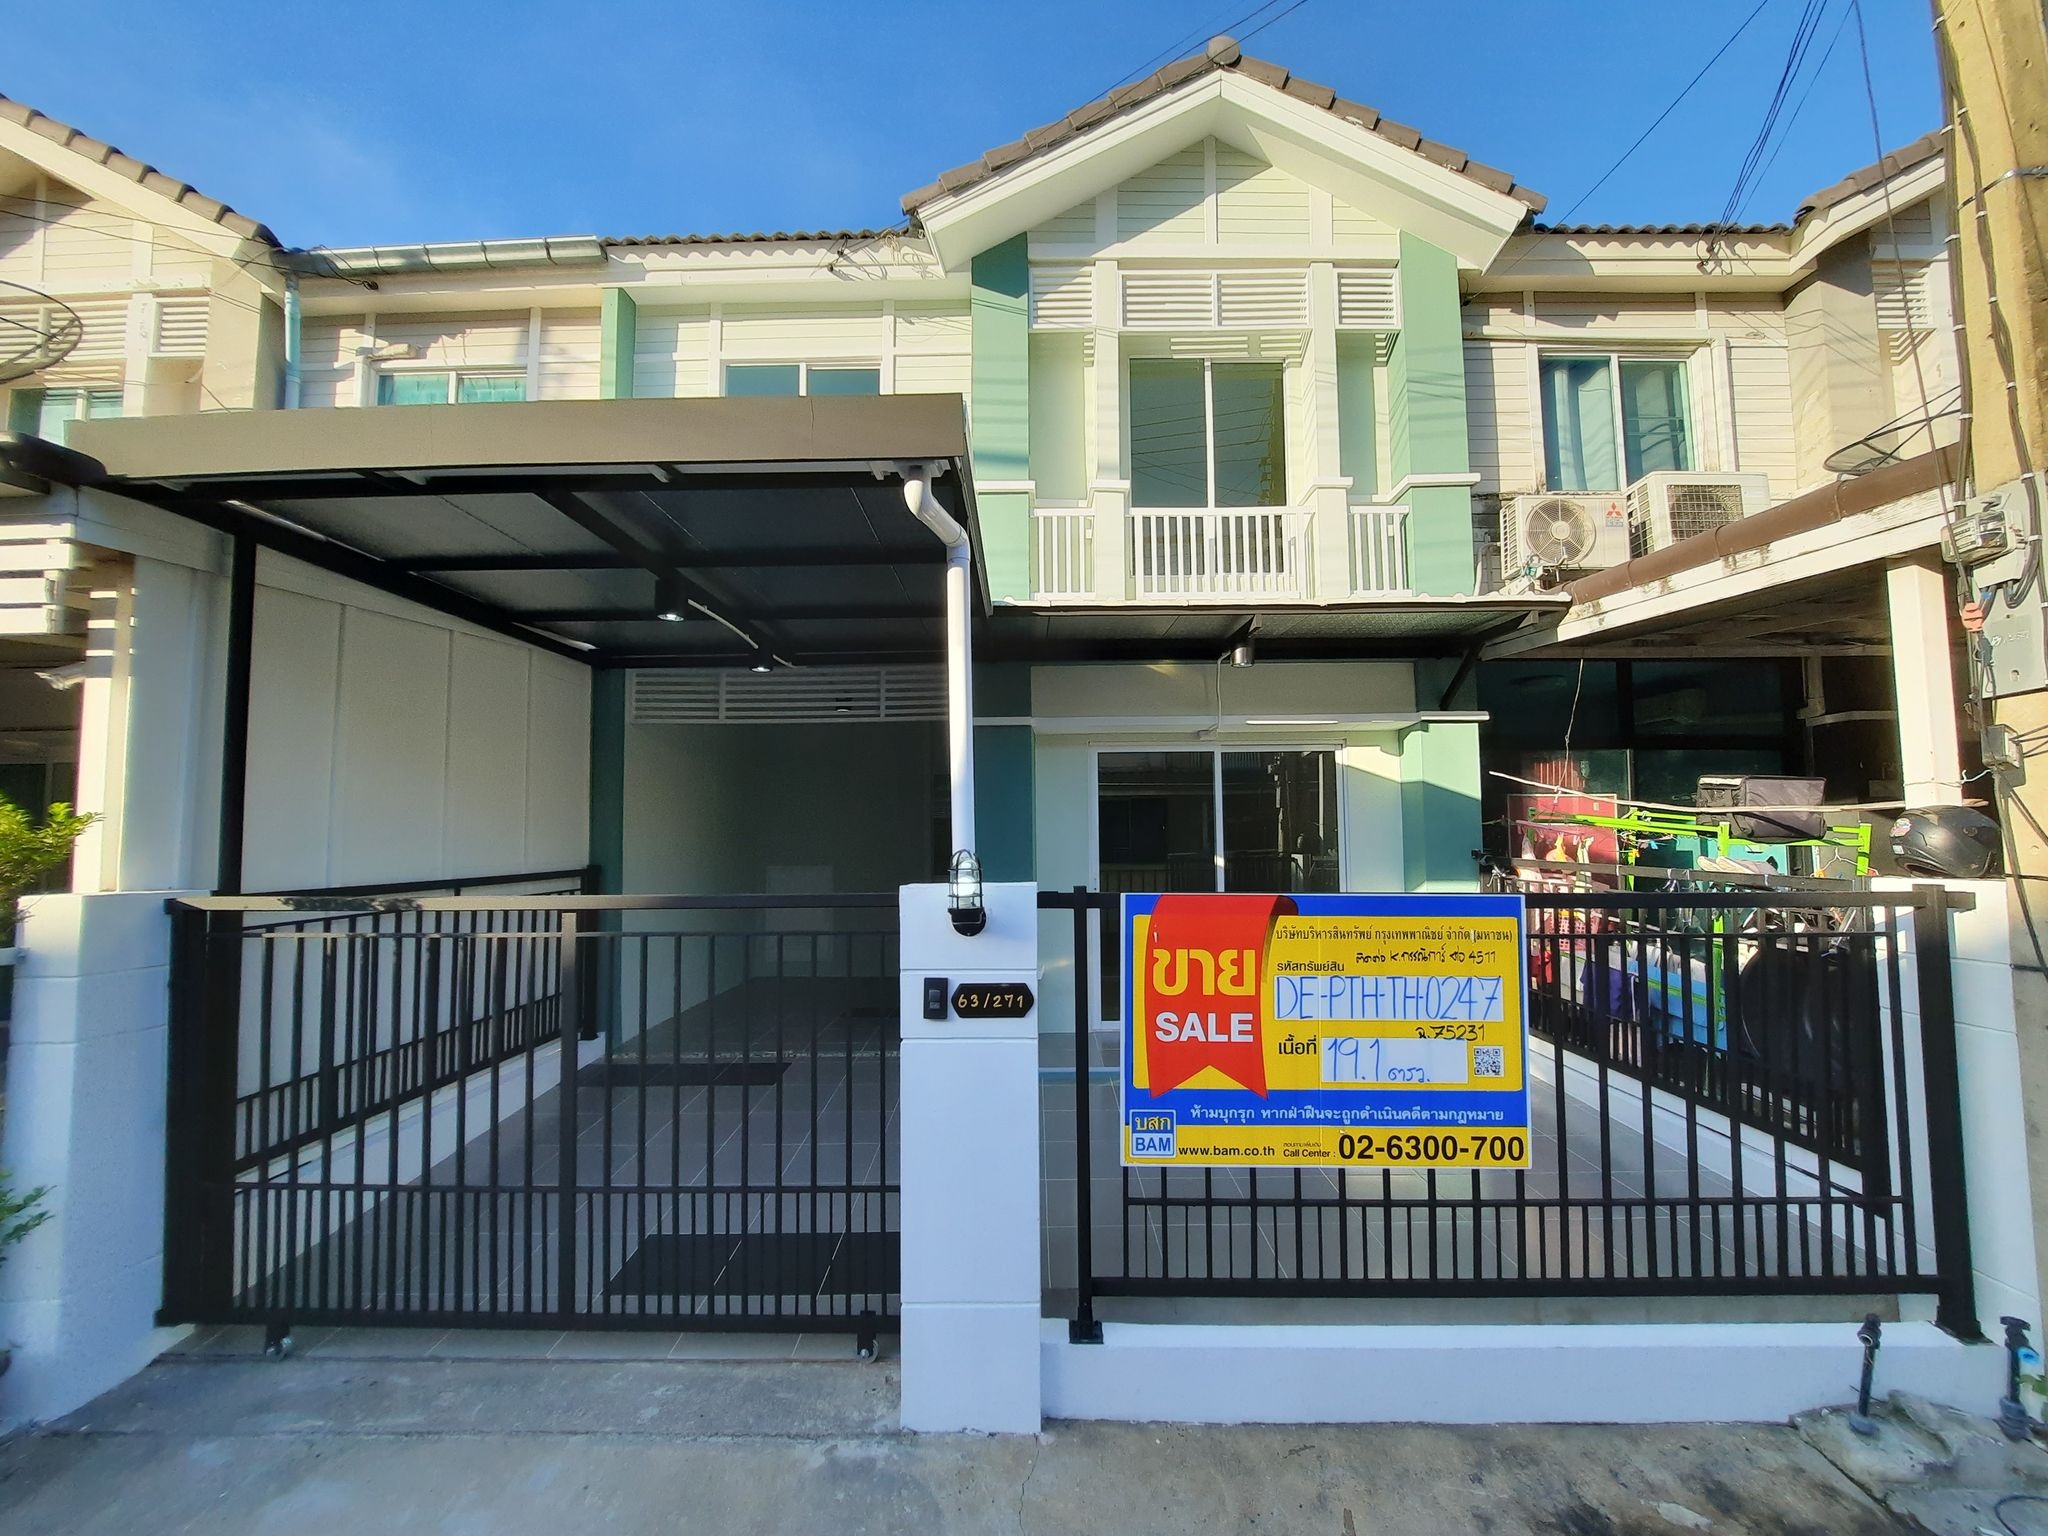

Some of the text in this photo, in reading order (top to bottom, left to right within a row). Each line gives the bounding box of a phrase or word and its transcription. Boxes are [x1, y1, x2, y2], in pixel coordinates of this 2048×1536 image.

[1276, 925, 1513, 944] บริษัทบริหารสินทรัพย์ กรุงเทพพาณิชย์ จำกัด (มหาชน)
[1152, 948, 1256, 996] ขาย
[1277, 960, 1345, 972] รหัสทรัพย์สิน
[958, 993, 1023, 1009] 63/271
[1155, 1012, 1254, 1043] SALE
[1278, 1034, 1317, 1055] เนื้อที่
[1328, 1037, 1380, 1082] 19.1
[1136, 1116, 1171, 1131] บสก
[1191, 1104, 1504, 1125] ห้ามบุกรุก หากฝ่าฝืนจะถูกดำเนินคดีตามกฎหมาย
[1136, 1138, 1171, 1152] BAM
[1179, 1145, 1275, 1156] www.bam.co.th
[1283, 1149, 1300, 1158] Call
[1302, 1149, 1331, 1158] Center
[1338, 1135, 1525, 1161] 02-6300-700
